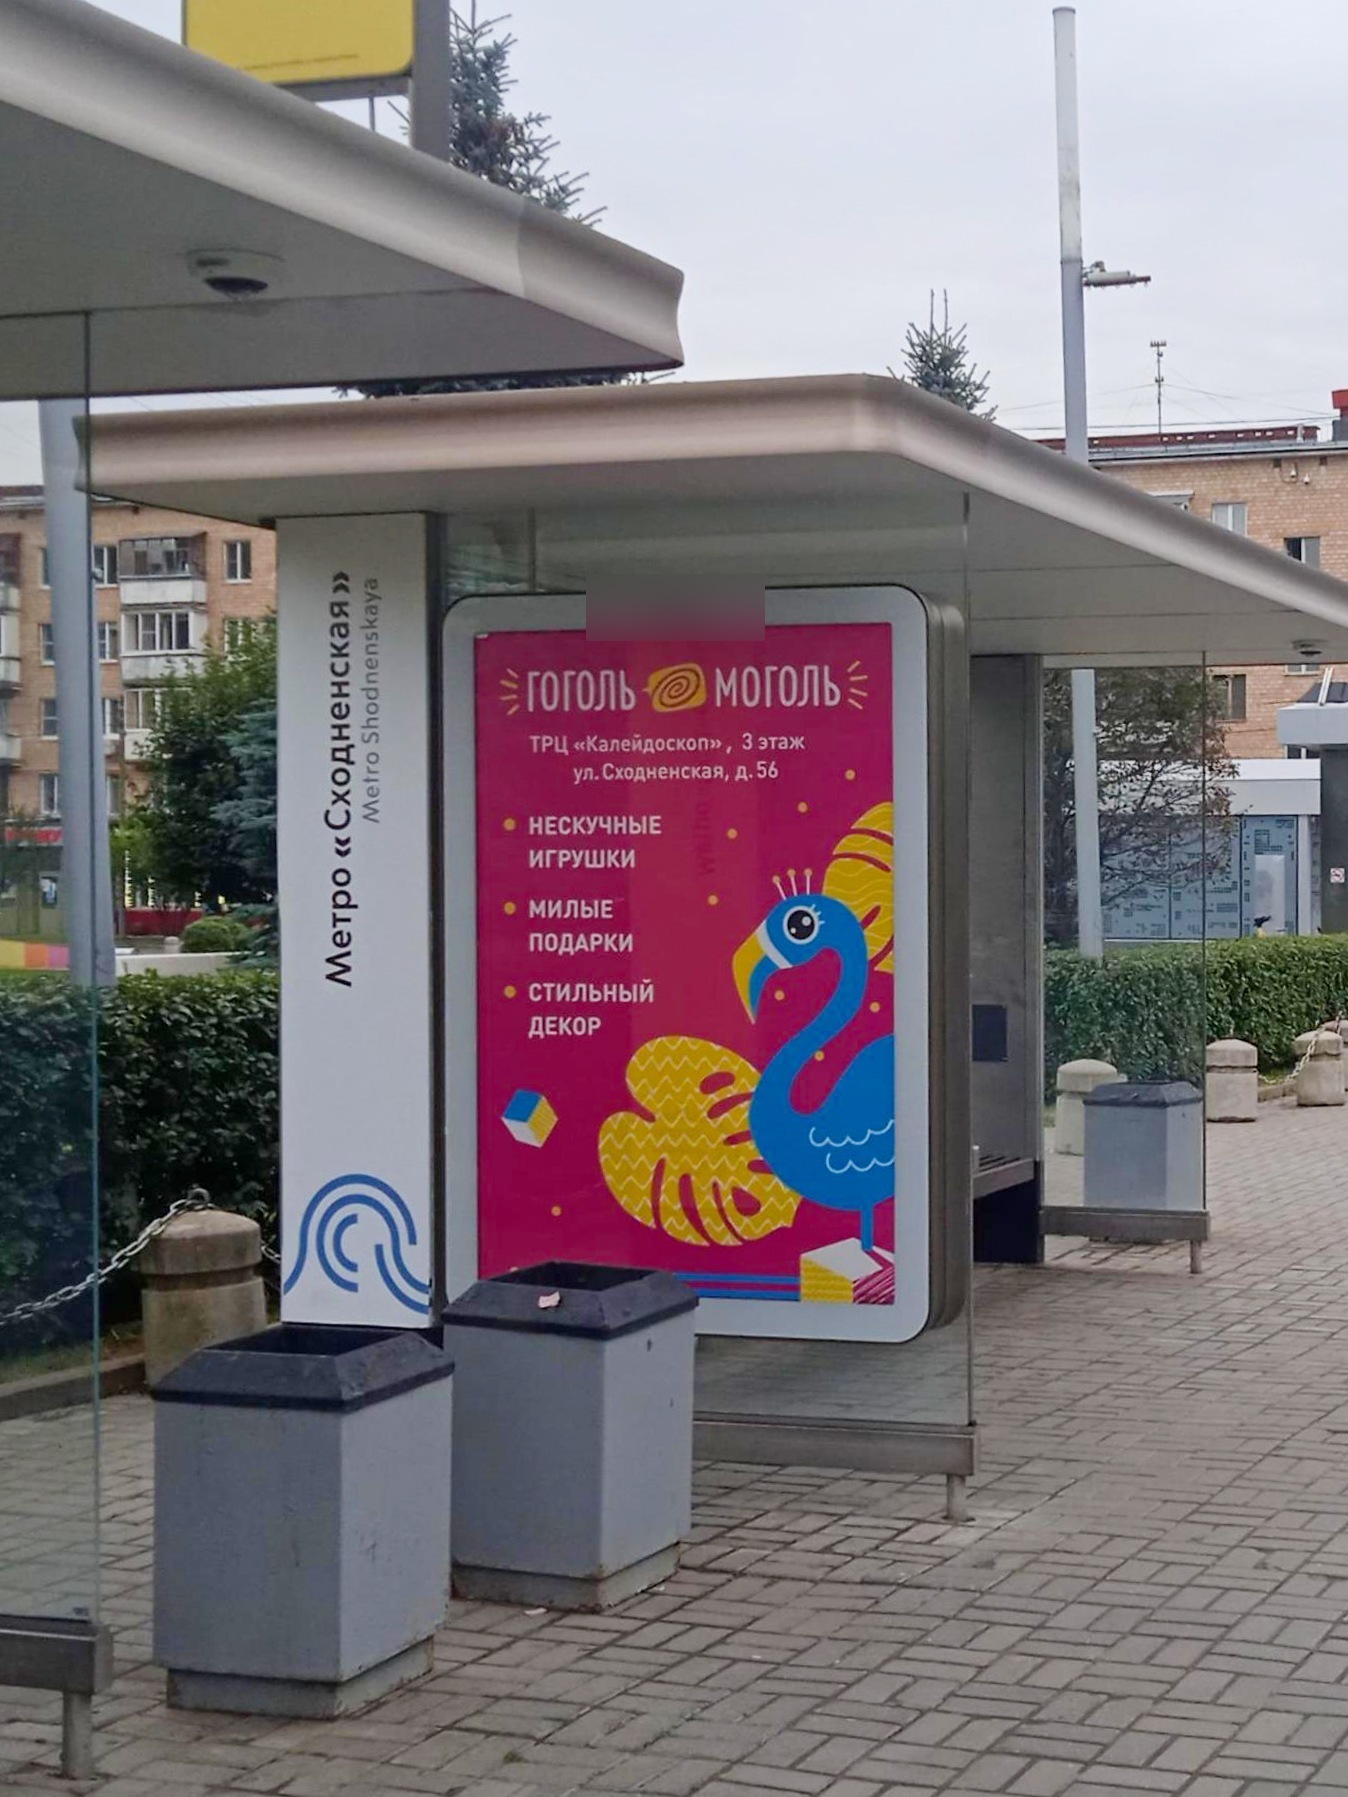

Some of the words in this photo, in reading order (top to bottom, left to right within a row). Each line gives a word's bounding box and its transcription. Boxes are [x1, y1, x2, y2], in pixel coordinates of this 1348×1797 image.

[359, 577, 383, 744] Shodnenskaya
[526, 669, 637, 712] ГОГОЛЬ
[714, 664, 842, 708] МОГОЛЬ
[529, 734, 569, 756] ТРЦ
[742, 732, 753, 751] 3
[758, 734, 806, 750] этаж
[573, 768, 599, 785] ул.
[602, 763, 730, 782] Сходненская,
[734, 766, 753, 780] д.
[756, 761, 779, 779] 56
[361, 750, 381, 824] Metro
[528, 815, 662, 836] НЕСКУЧНЫЕ
[528, 848, 636, 869] ИГРУШКИ
[528, 899, 614, 919] МИЛЫЕ
[324, 867, 359, 988] Метро
[528, 932, 634, 956] ПОДАРКИ
[528, 978, 655, 1003] СТИЛЬНЫЙ
[527, 1016, 602, 1037] ДЕКОР
